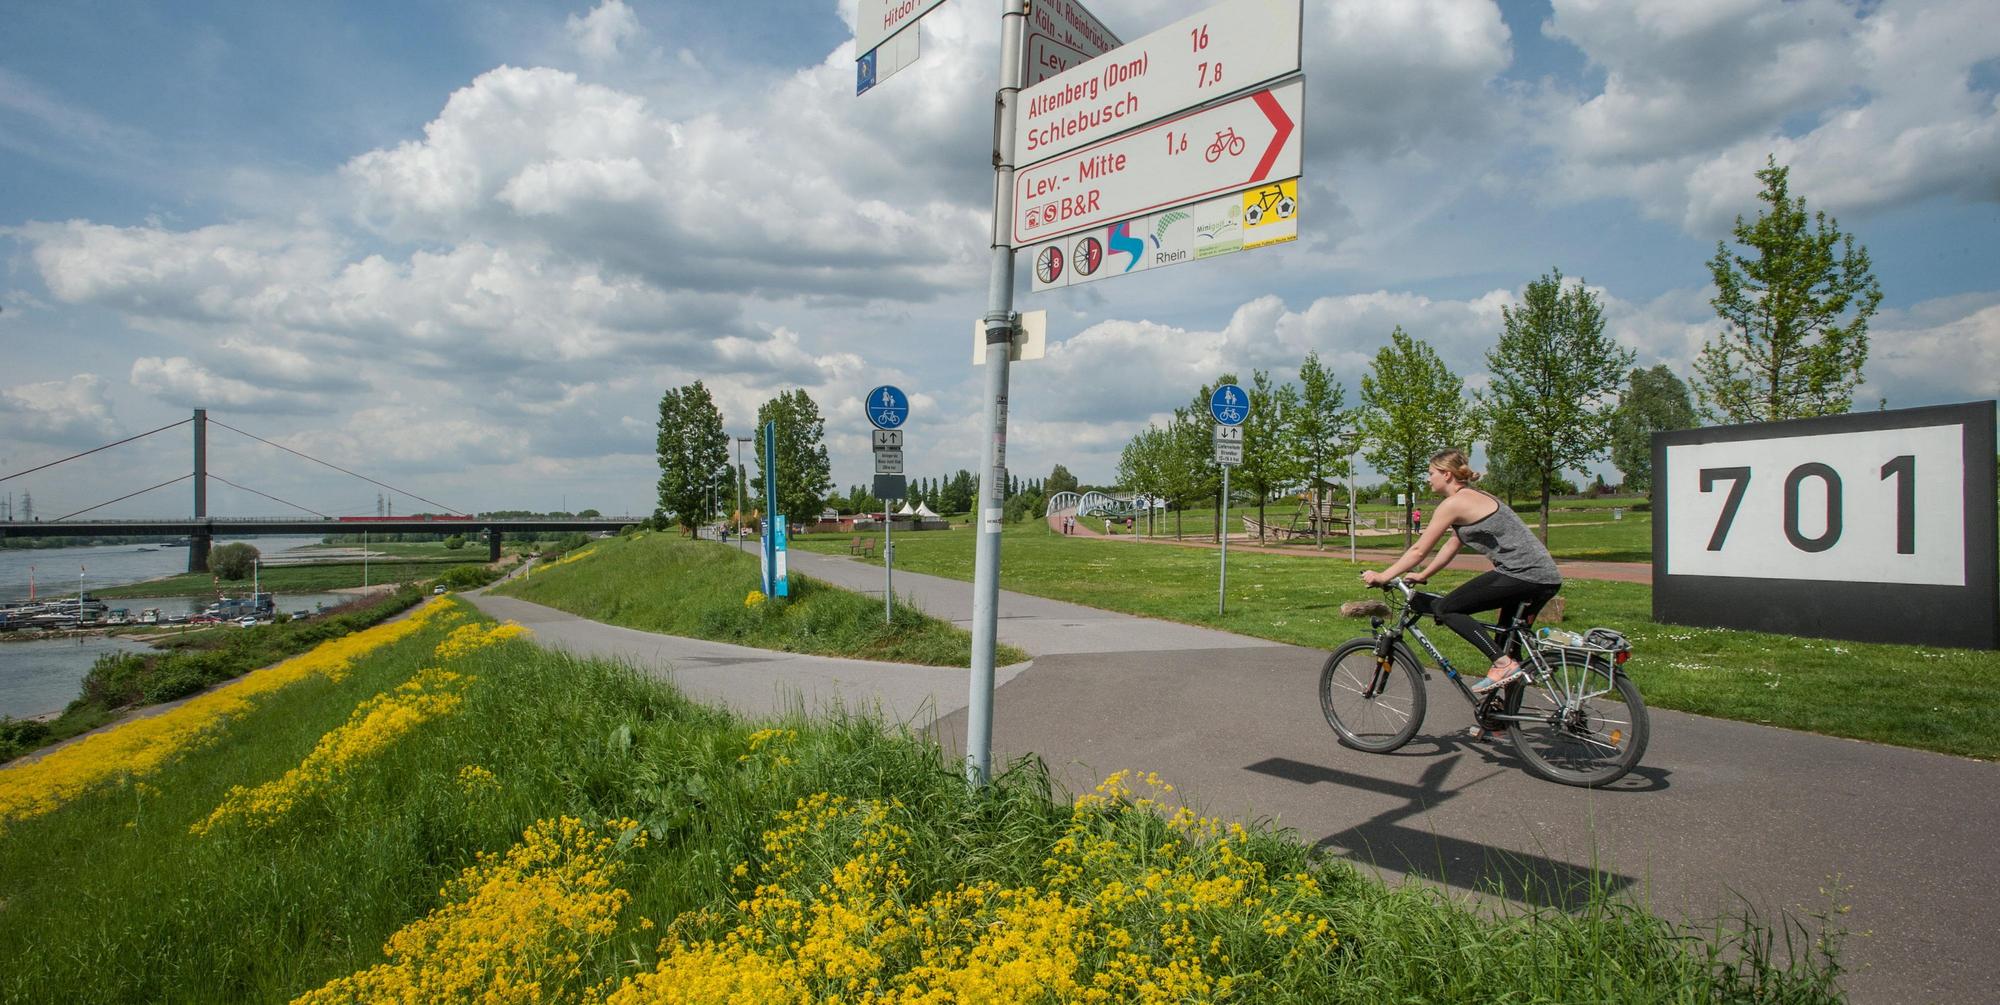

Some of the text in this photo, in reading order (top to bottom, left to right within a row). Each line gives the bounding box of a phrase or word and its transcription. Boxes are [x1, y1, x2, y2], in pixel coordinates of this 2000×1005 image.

[883, 0, 921, 30] Hitdor
[1035, 4, 1055, 38] Köln
[1065, 2, 1109, 54] Rheinbrücke
[1028, 23, 1209, 120] Altenberg (Dom) 16
[1027, 61, 1222, 150] Schlebusch 7,8
[1079, 153, 1127, 183] Mitte
[1166, 131, 1188, 156] 1,6
[1061, 189, 1100, 220] B&R
[1053, 257, 1060, 268] 8
[1091, 249, 1098, 260] 7
[1155, 250, 1186, 265] Rhein
[1699, 455, 1916, 555] 701
